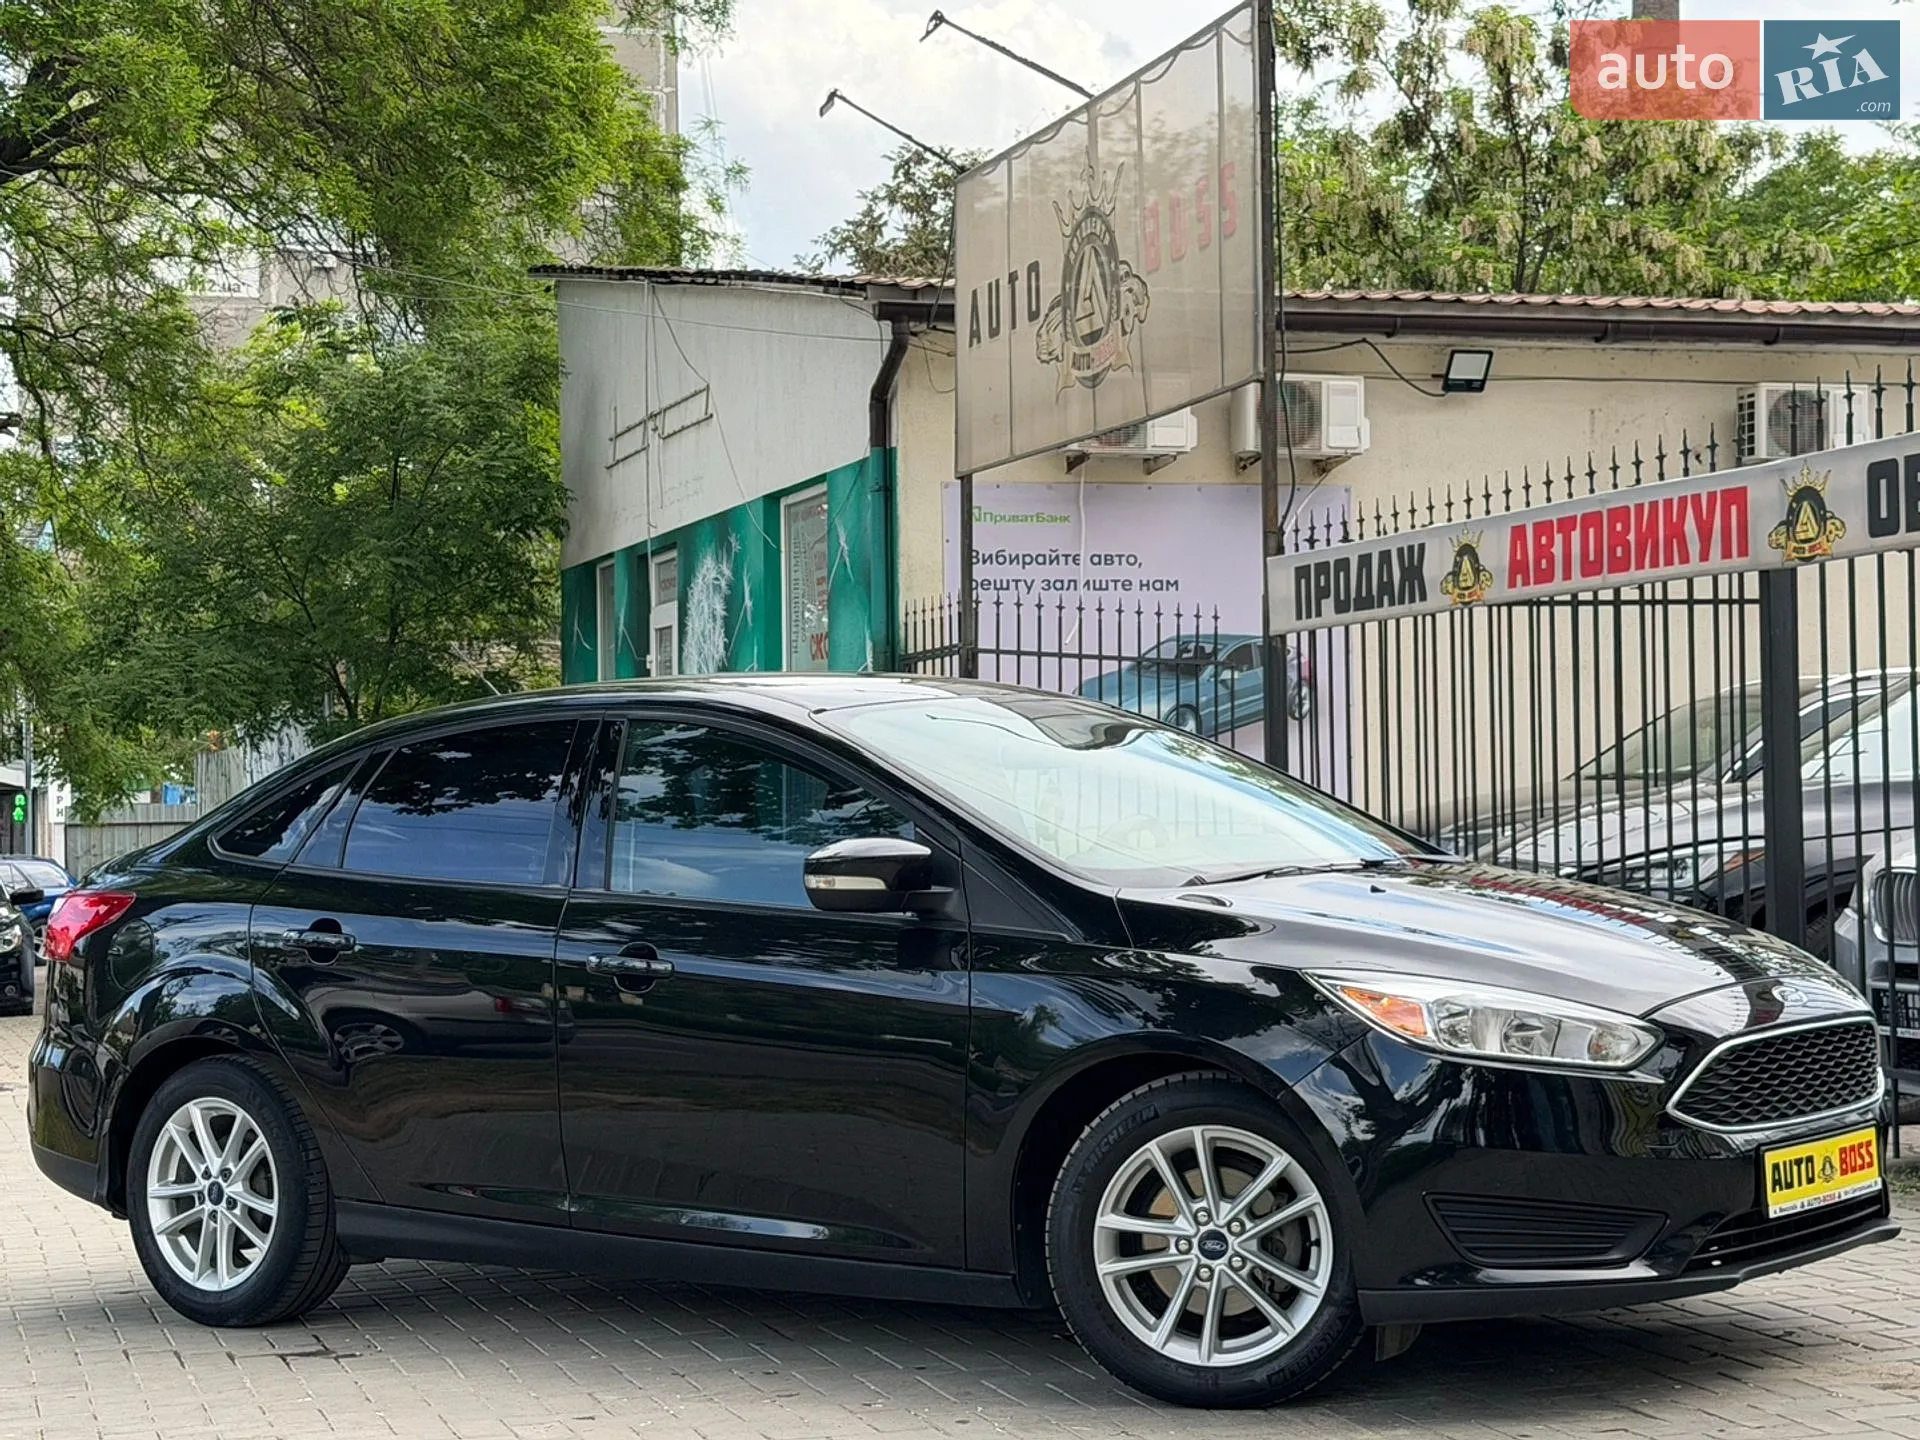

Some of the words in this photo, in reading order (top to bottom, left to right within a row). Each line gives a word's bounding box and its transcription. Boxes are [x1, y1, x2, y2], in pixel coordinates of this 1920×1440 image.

[968, 260, 1041, 348] AUTO
[1142, 160, 1238, 276] BOSS
[982, 511, 1071, 524] ПриватБанк
[972, 548, 1081, 570] Вибирайте
[1089, 553, 1143, 568] авто,
[1294, 542, 1428, 621] ПРОДАЖ
[1507, 485, 1750, 590] АВТОВИКУП
[1040, 578, 1133, 591] залиште
[1138, 579, 1179, 591] нам
[1771, 1154, 1816, 1194] AUTO
[1838, 1140, 1875, 1177] BOSS
